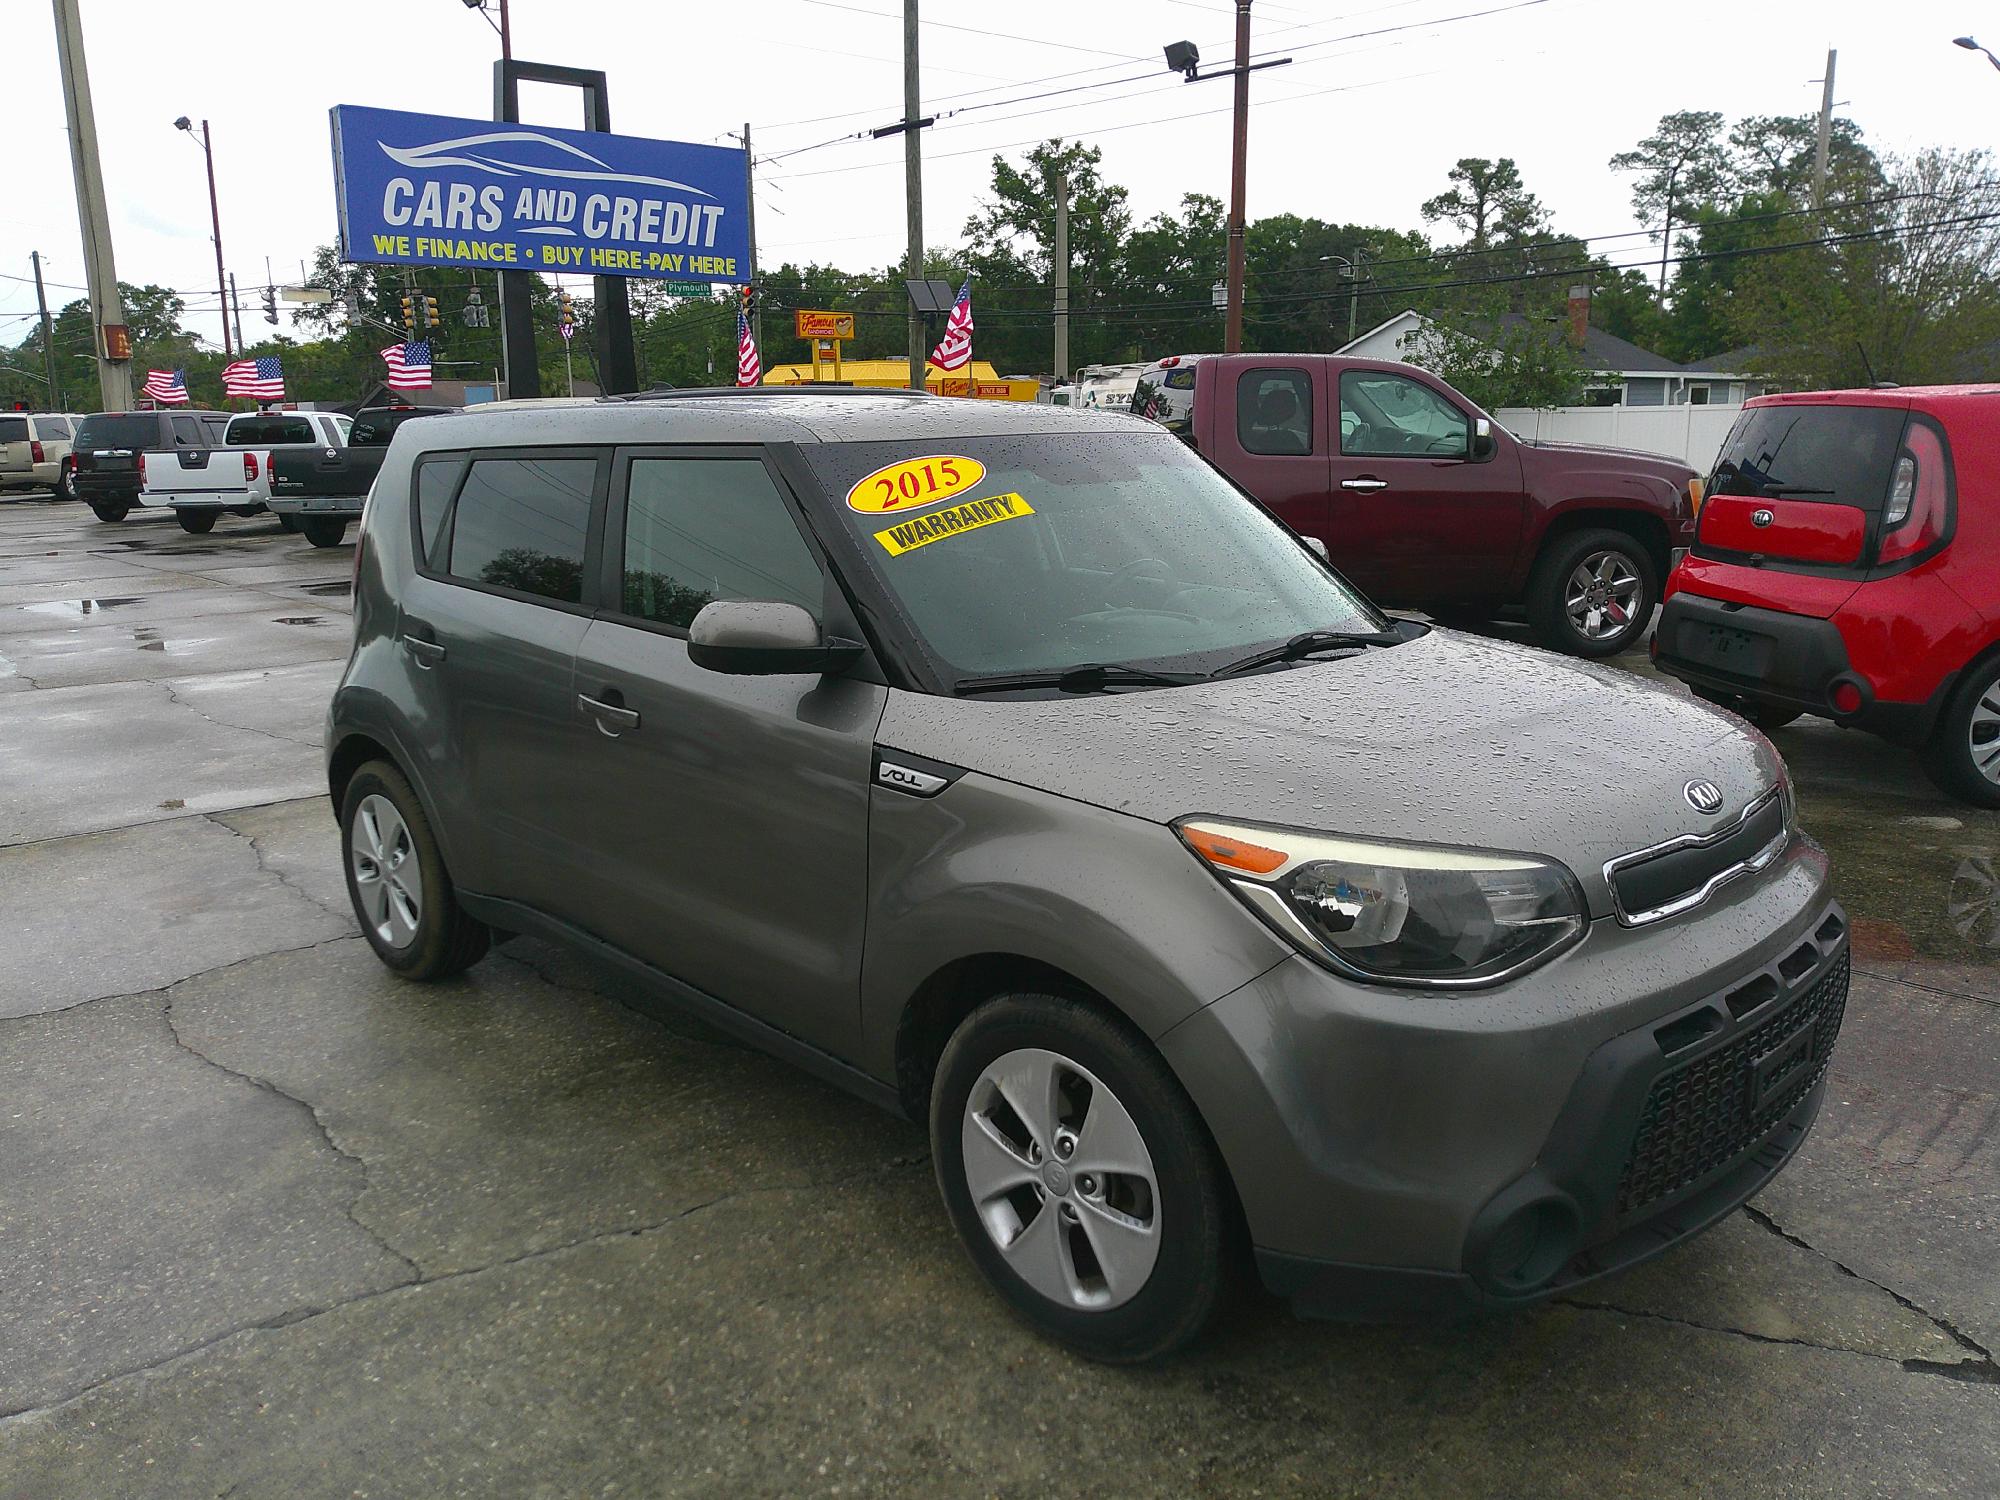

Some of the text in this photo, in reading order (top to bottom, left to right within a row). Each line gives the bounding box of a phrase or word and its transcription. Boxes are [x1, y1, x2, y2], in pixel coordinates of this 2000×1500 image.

[384, 178, 725, 247] CARS AND CREDIT
[373, 235, 737, 276] WE FINANCE BUY HERE-PAY HERE
[668, 283, 709, 293] Plymouth
[875, 459, 961, 509] 2015
[888, 496, 1016, 549] WARRANTY
[881, 769, 922, 787] SOUL
[1688, 781, 1723, 809] KIA
